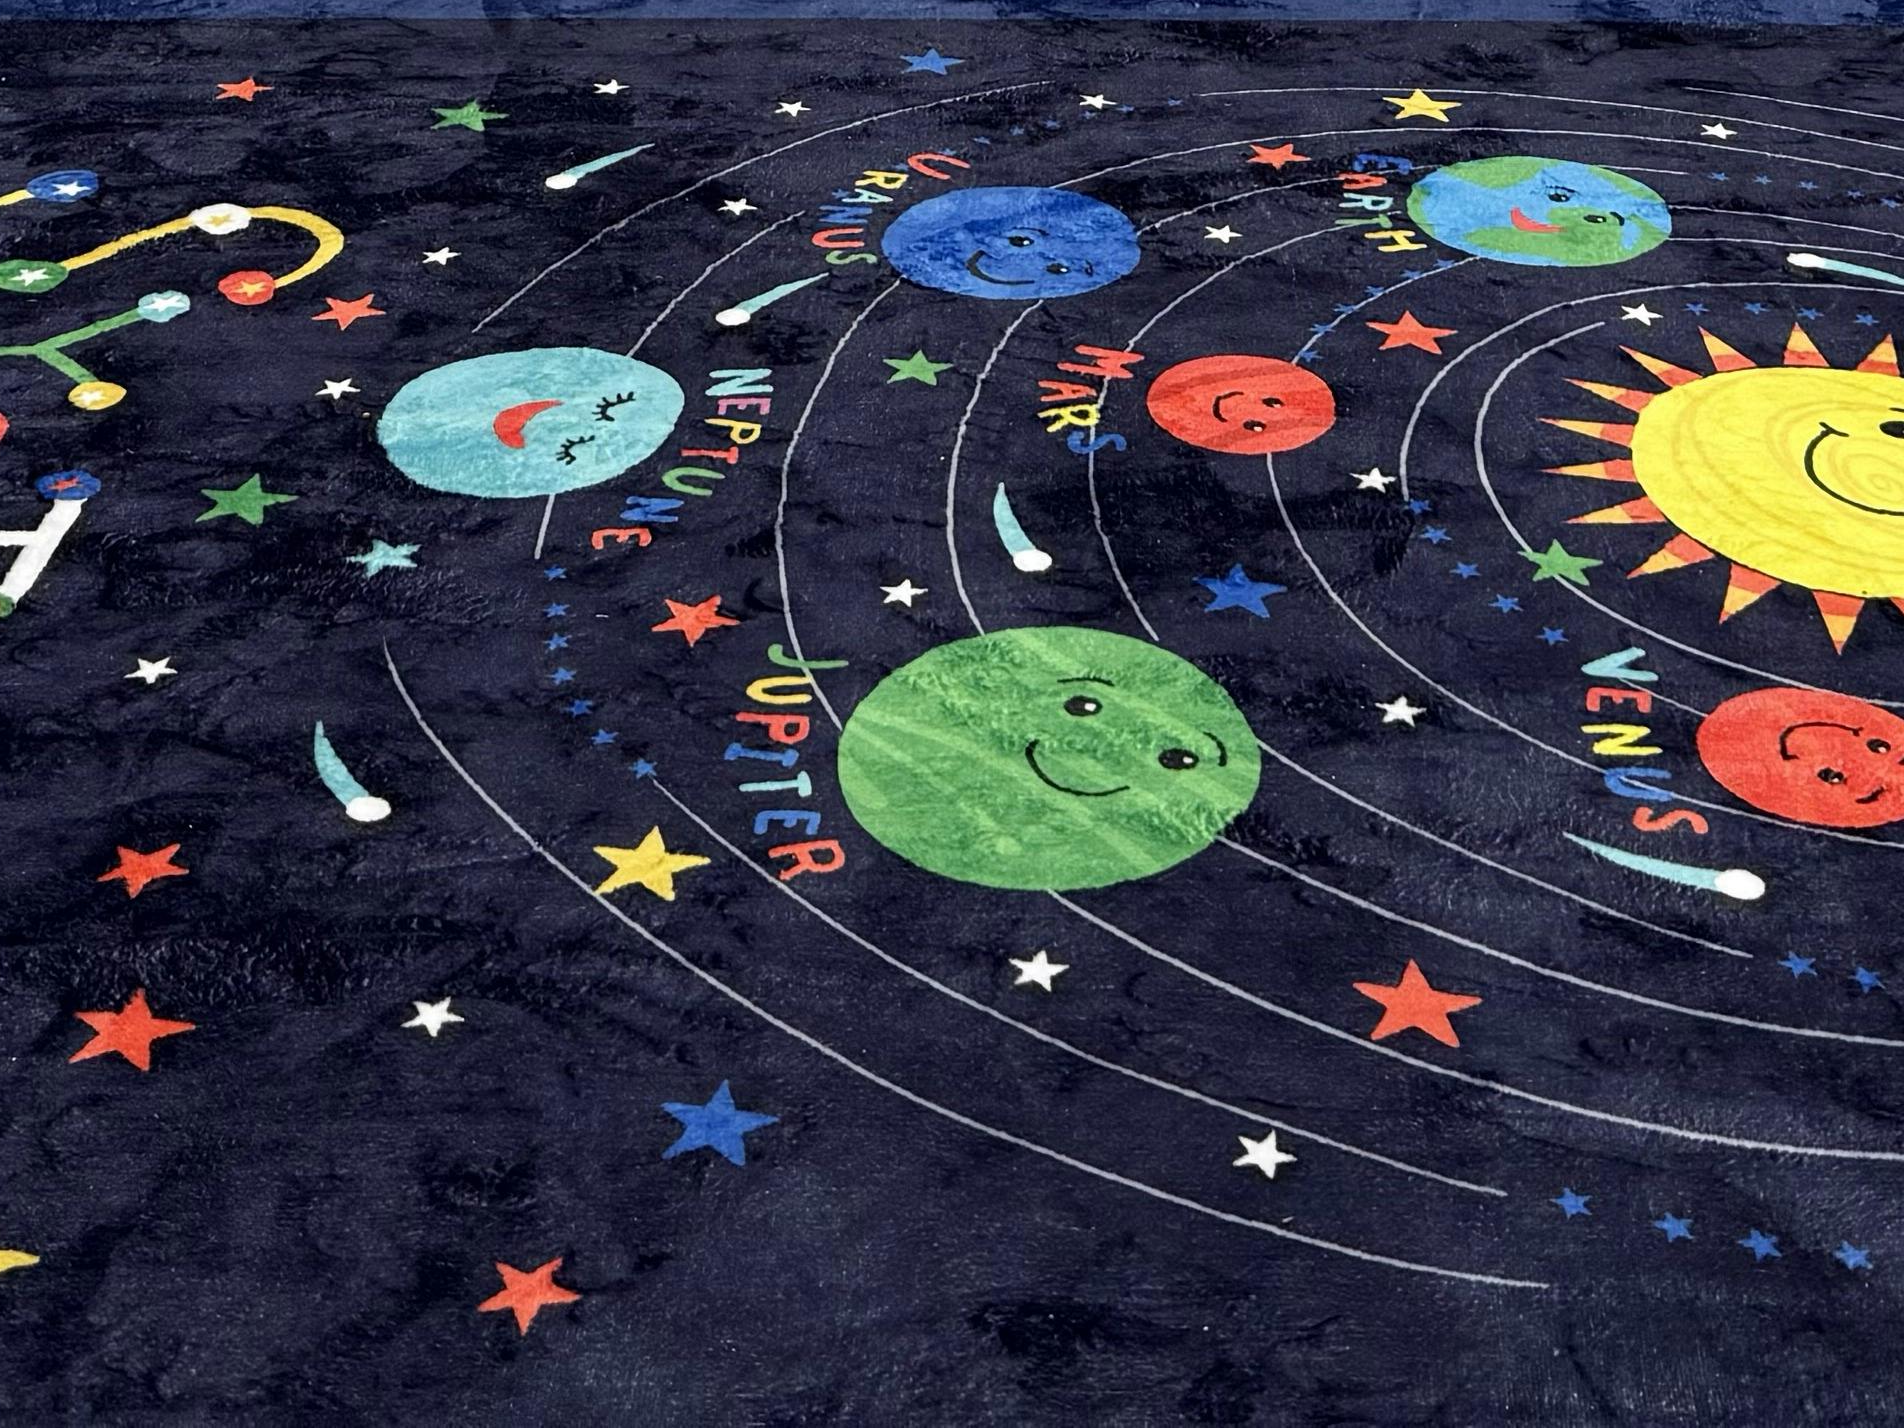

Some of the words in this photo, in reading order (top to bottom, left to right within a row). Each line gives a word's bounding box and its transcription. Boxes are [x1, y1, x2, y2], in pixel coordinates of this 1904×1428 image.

[810, 150, 971, 269] URANUS
[1335, 153, 1427, 255] EARTH
[591, 367, 773, 551] NEPTUNE
[1037, 345, 1145, 457] MARS
[723, 642, 848, 882] JUPITER
[1578, 646, 1709, 836] VENUS
